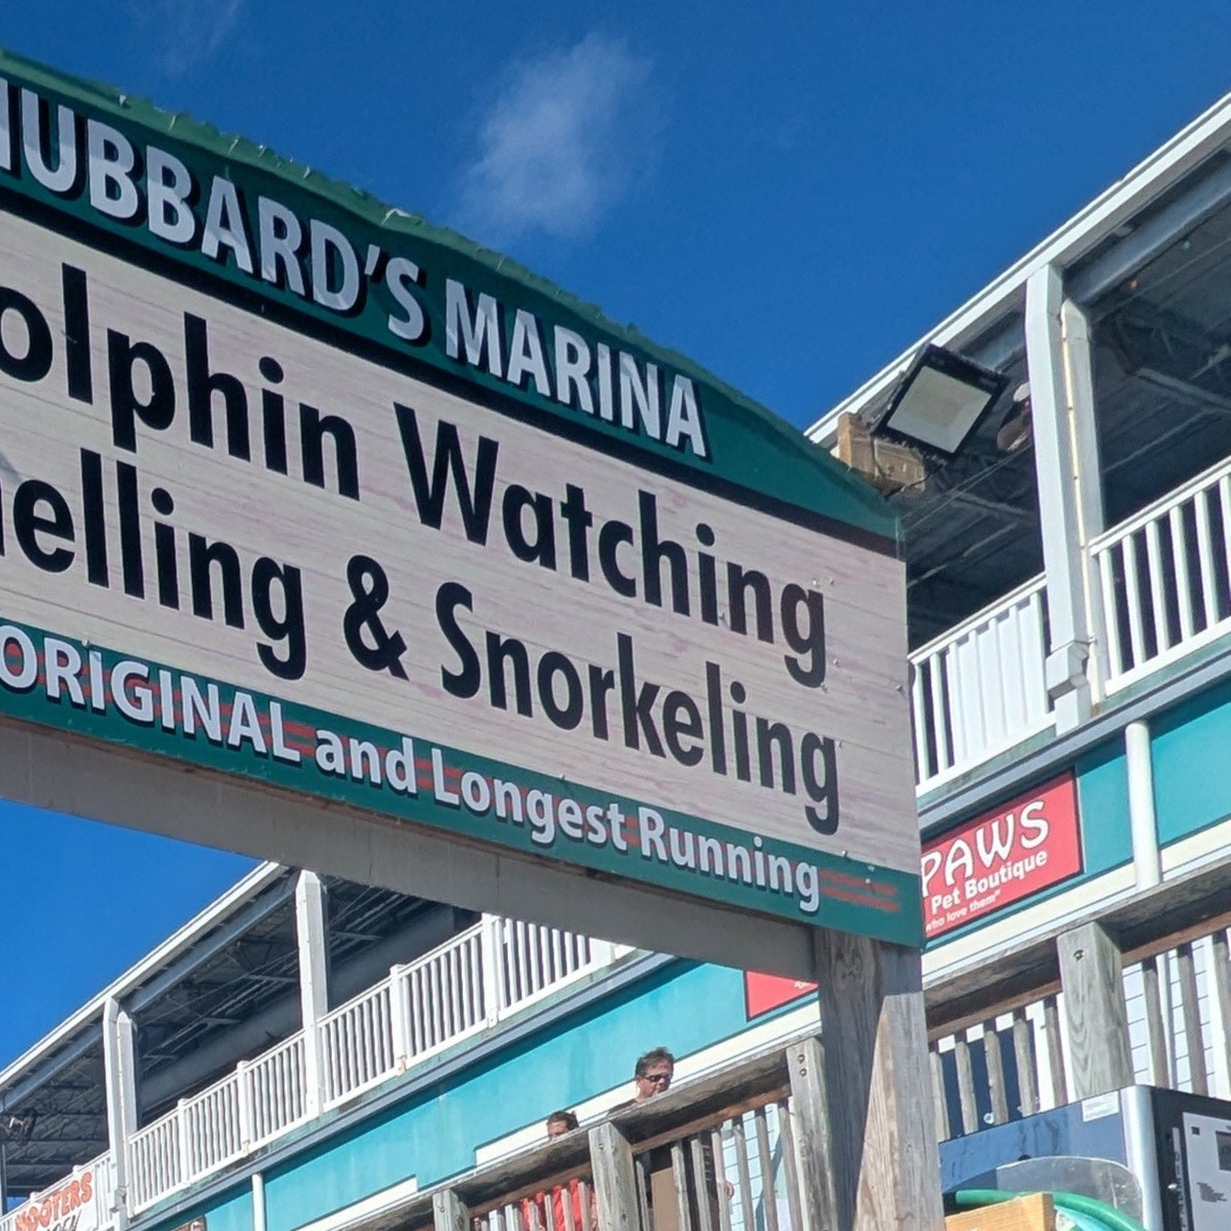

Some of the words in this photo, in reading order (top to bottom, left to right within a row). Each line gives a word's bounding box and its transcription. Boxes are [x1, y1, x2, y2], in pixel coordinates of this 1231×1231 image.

[444, 280, 707, 458] MARINA
[394, 402, 826, 689] Watching
[343, 555, 410, 681] &
[435, 582, 840, 836] Snorkeling
[315, 728, 418, 795] and
[431, 748, 628, 851] Longest
[638, 806, 821, 913] Running
[921, 800, 1049, 898] PAWS
[931, 887, 961, 915] Pet
[964, 850, 1048, 899] Boutique
[946, 907, 969, 923] love
